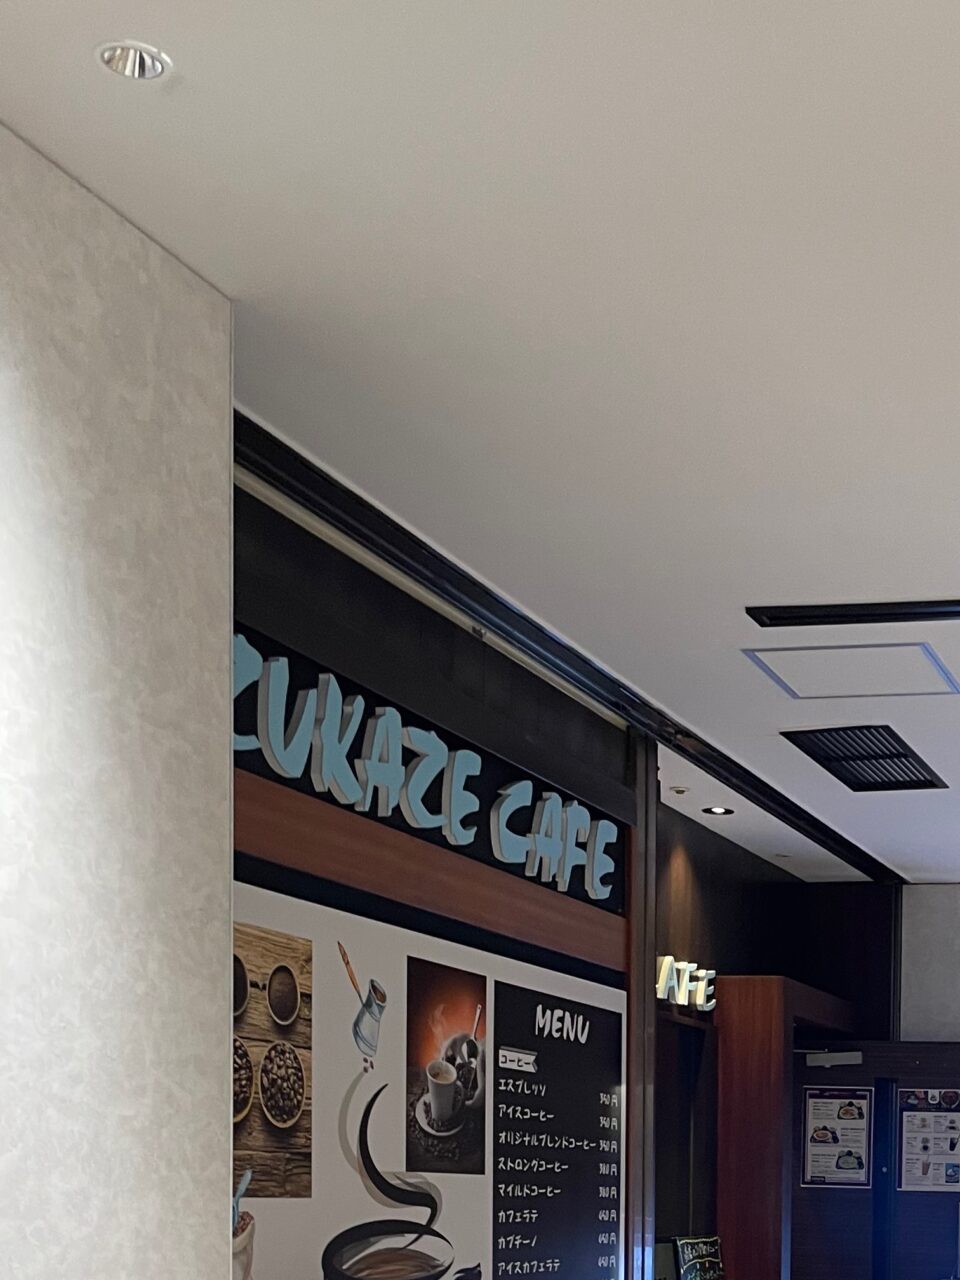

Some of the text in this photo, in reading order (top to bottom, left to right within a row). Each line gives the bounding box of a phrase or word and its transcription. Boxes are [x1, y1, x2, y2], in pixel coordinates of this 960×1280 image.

[489, 780, 619, 901] CAFE
[535, 1004, 589, 1044] MENU
[501, 1054, 531, 1067] コーヒー
[498, 1104, 555, 1121] アイスコーヒー
[498, 1157, 569, 1173] ストロングコーヒー
[498, 1184, 561, 1197] マイルドコーヒー
[498, 1209, 538, 1223] カフェラテ
[497, 1259, 560, 1276] アイスカフェラテ
